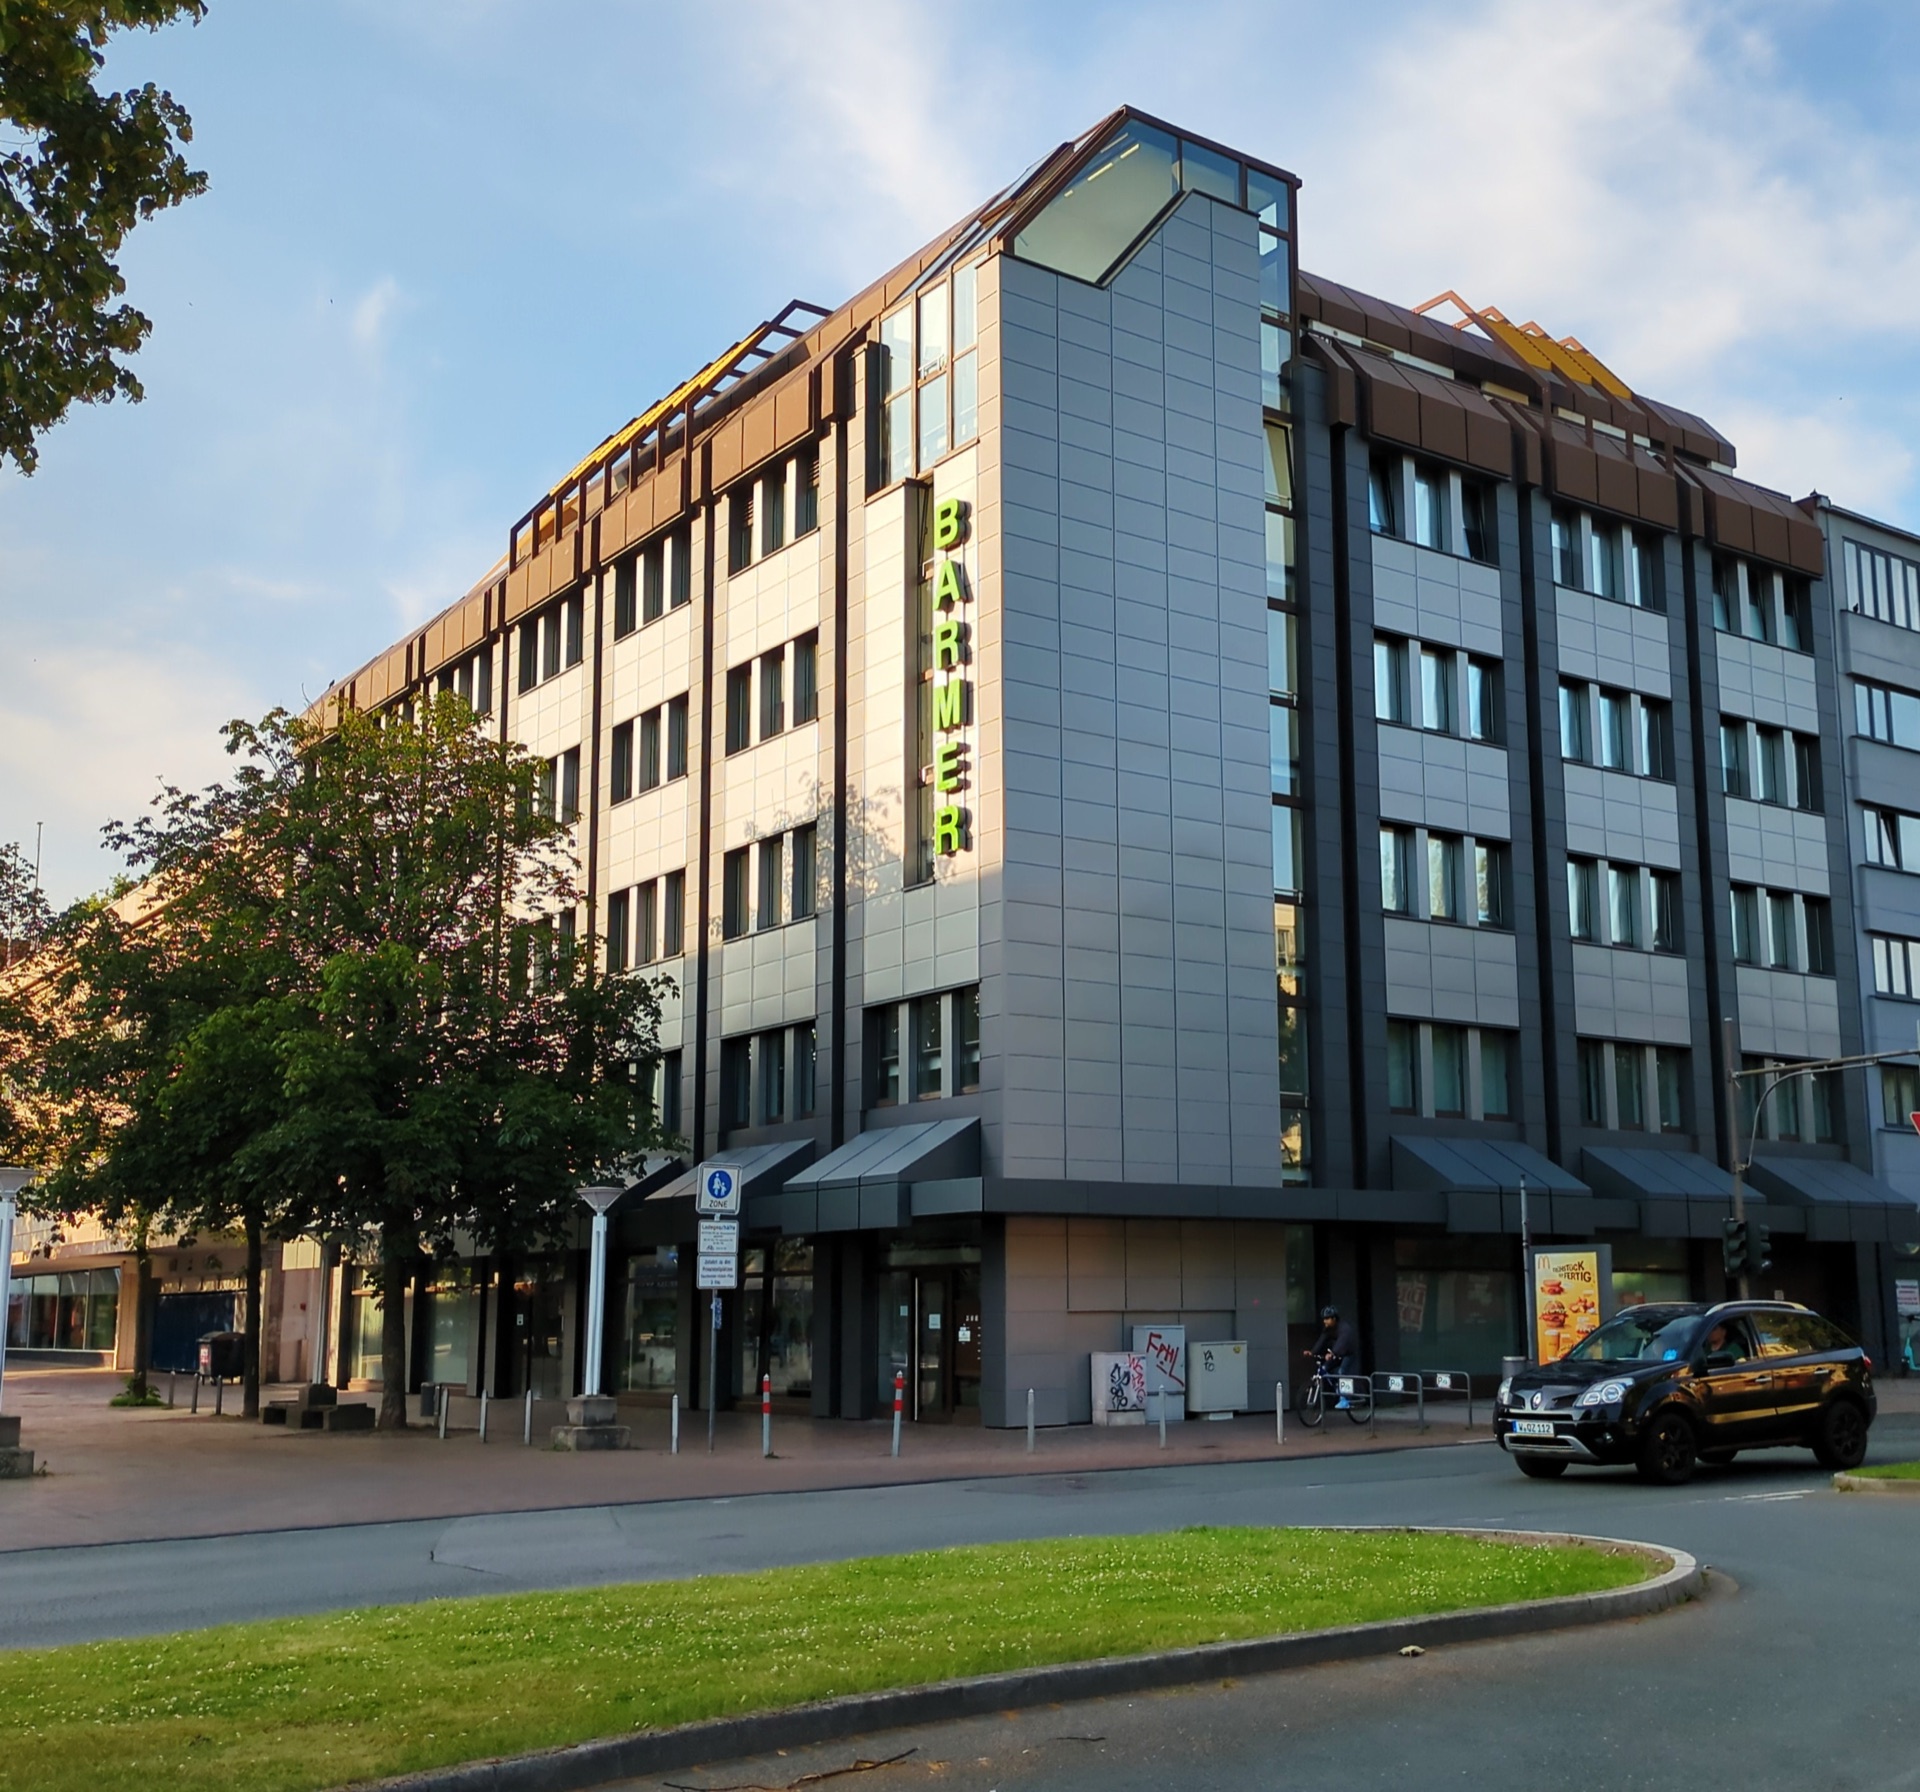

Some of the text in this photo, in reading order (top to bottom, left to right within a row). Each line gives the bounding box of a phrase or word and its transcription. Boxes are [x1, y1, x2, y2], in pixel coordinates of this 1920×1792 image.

[932, 497, 967, 855] BARMER
[709, 1199, 728, 1208] ZONE
[1564, 1271, 1592, 1283] FERTIG
